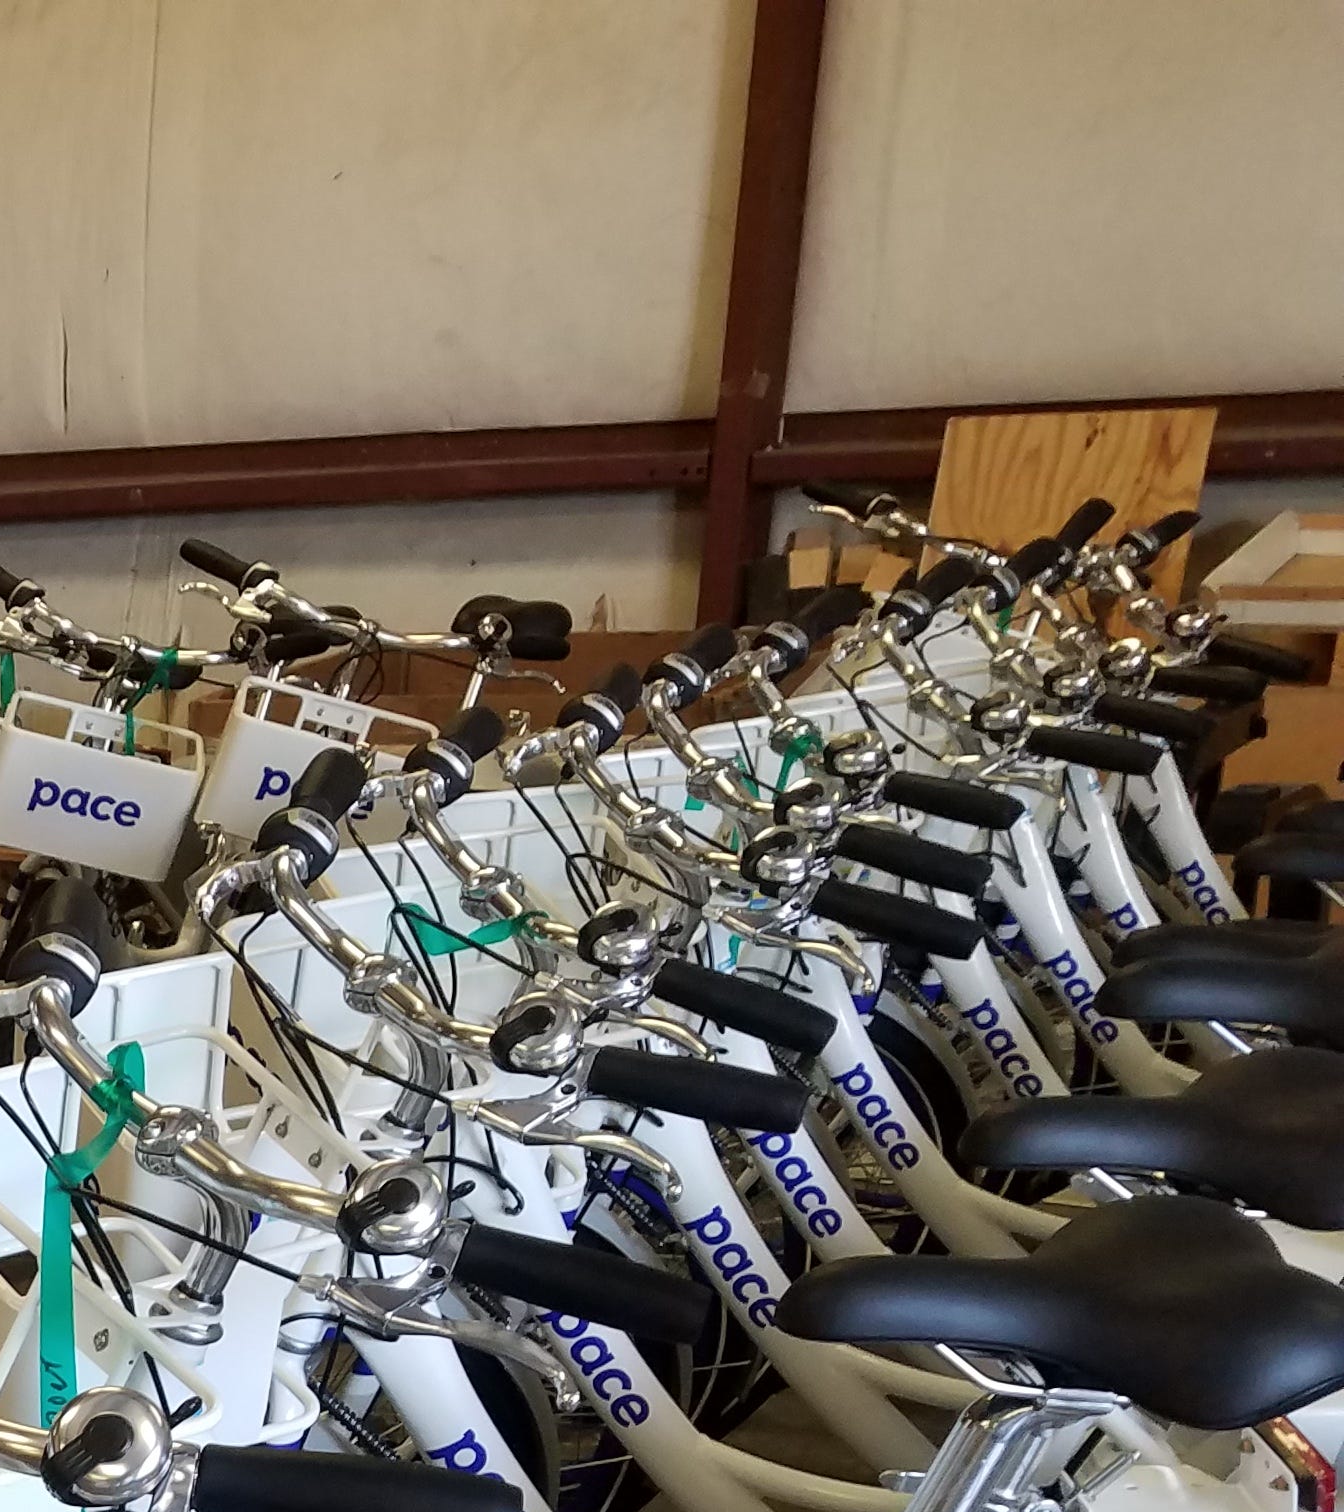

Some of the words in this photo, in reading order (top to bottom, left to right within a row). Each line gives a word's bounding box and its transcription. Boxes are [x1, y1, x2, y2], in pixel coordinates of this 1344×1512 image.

[27, 777, 142, 828] pace
[961, 997, 1044, 1098] pace
[831, 1062, 921, 1172] pace
[747, 1130, 843, 1239] pace
[684, 1205, 778, 1329] pace
[537, 1309, 651, 1429] pace
